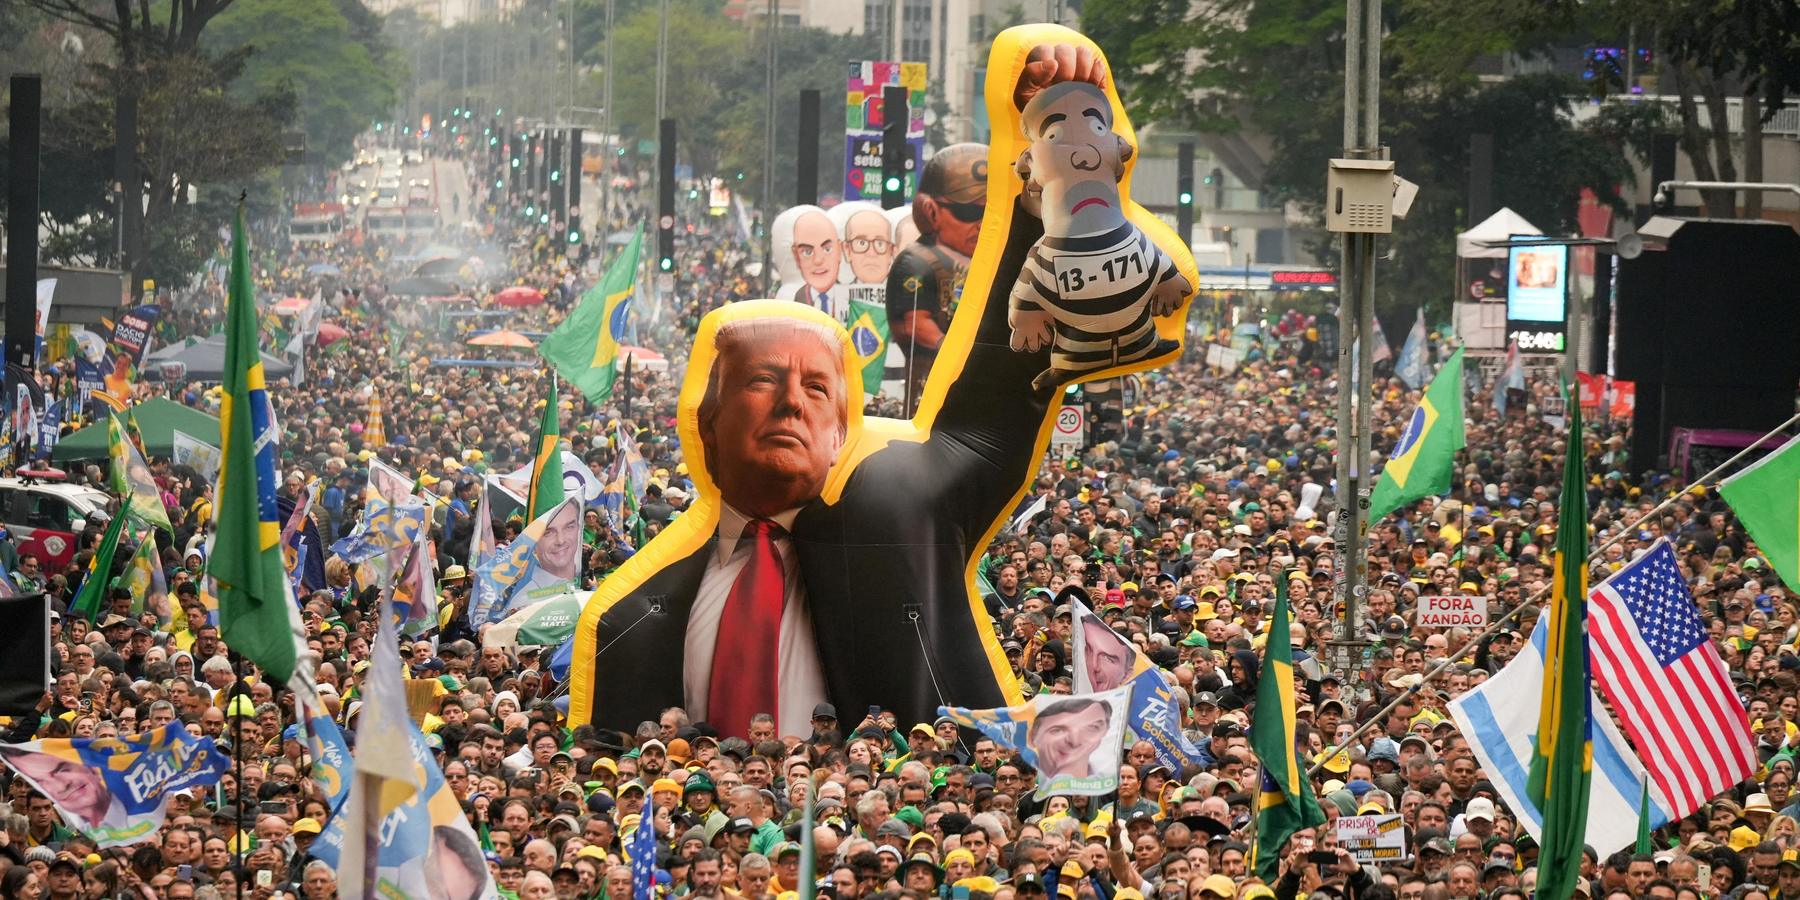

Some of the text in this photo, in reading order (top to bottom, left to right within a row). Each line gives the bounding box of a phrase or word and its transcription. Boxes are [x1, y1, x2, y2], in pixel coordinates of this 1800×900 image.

[1059, 268, 1084, 292] 13
[1102, 252, 1142, 282] 171
[1060, 413, 1077, 425] 20
[1429, 598, 1474, 611] FORA
[1421, 611, 1483, 625] XANDÃO
[1339, 816, 1375, 829] PRISÃO
